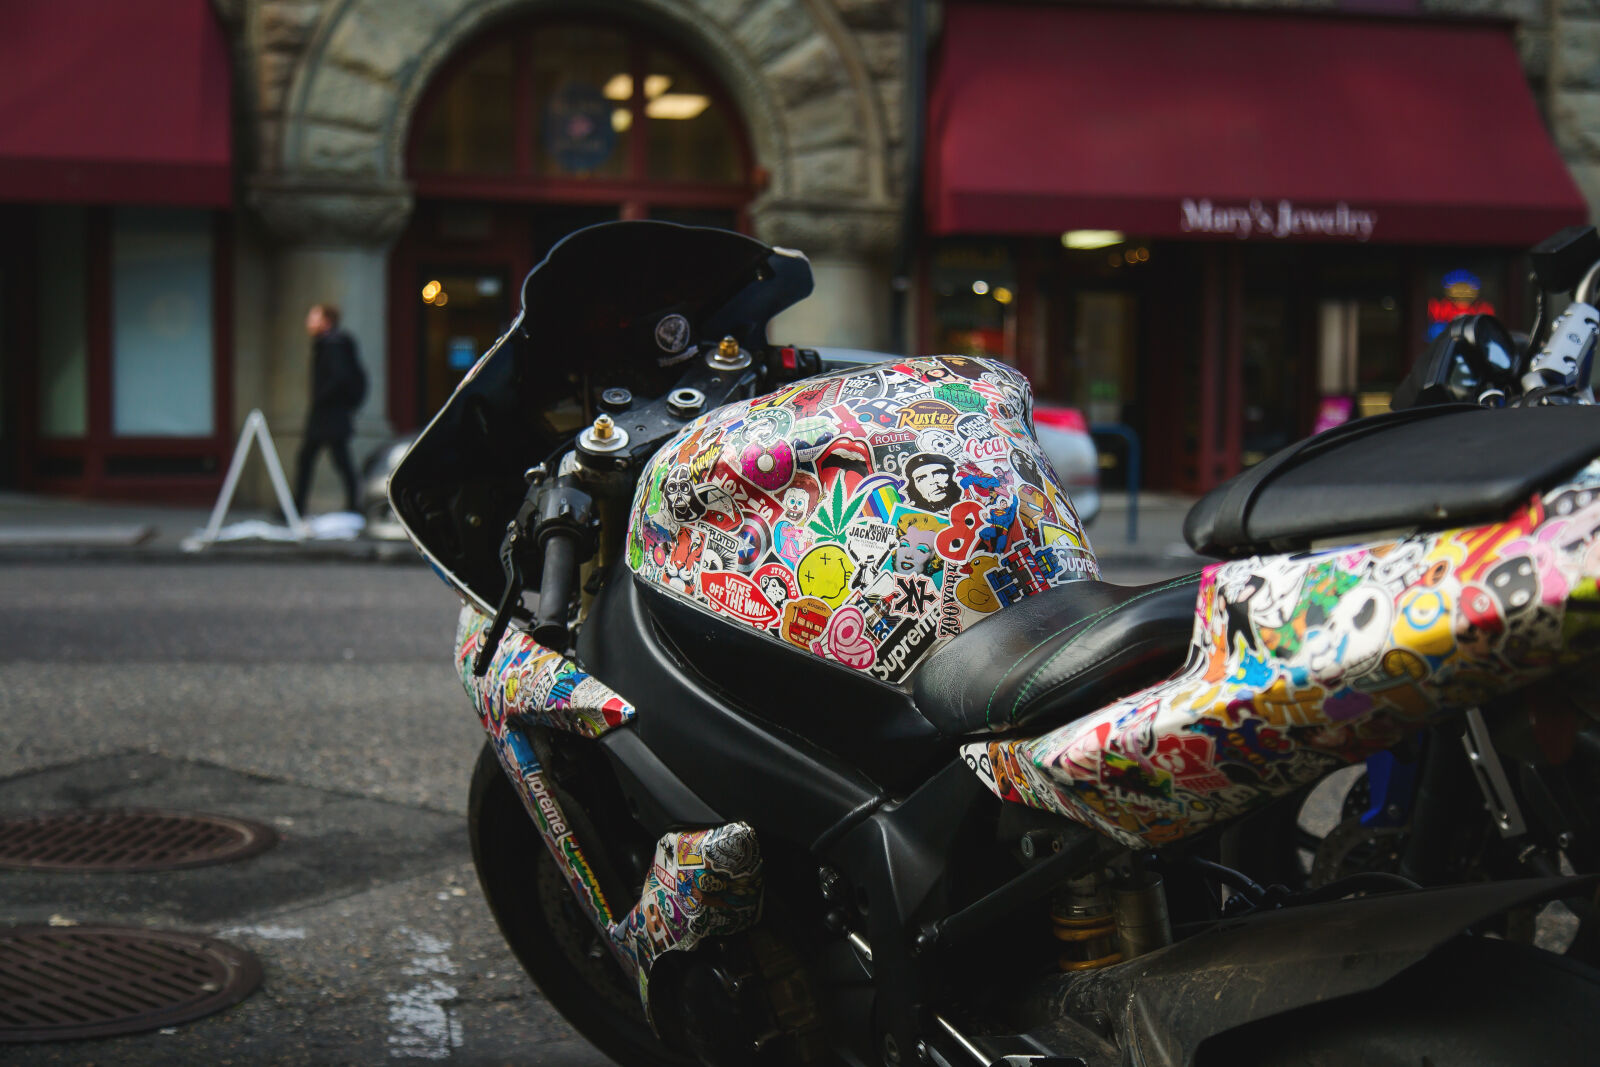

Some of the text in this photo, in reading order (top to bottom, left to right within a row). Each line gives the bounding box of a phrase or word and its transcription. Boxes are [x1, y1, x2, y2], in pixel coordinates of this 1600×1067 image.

[1180, 198, 1377, 241] Mary's Jewelry
[875, 432, 911, 444] ROUTE
[888, 444, 901, 453] US
[849, 526, 889, 543] JACKSON
[869, 524, 895, 536] MICHAEL
[725, 576, 752, 598] VANS
[709, 582, 771, 616] OFF THE WALL
